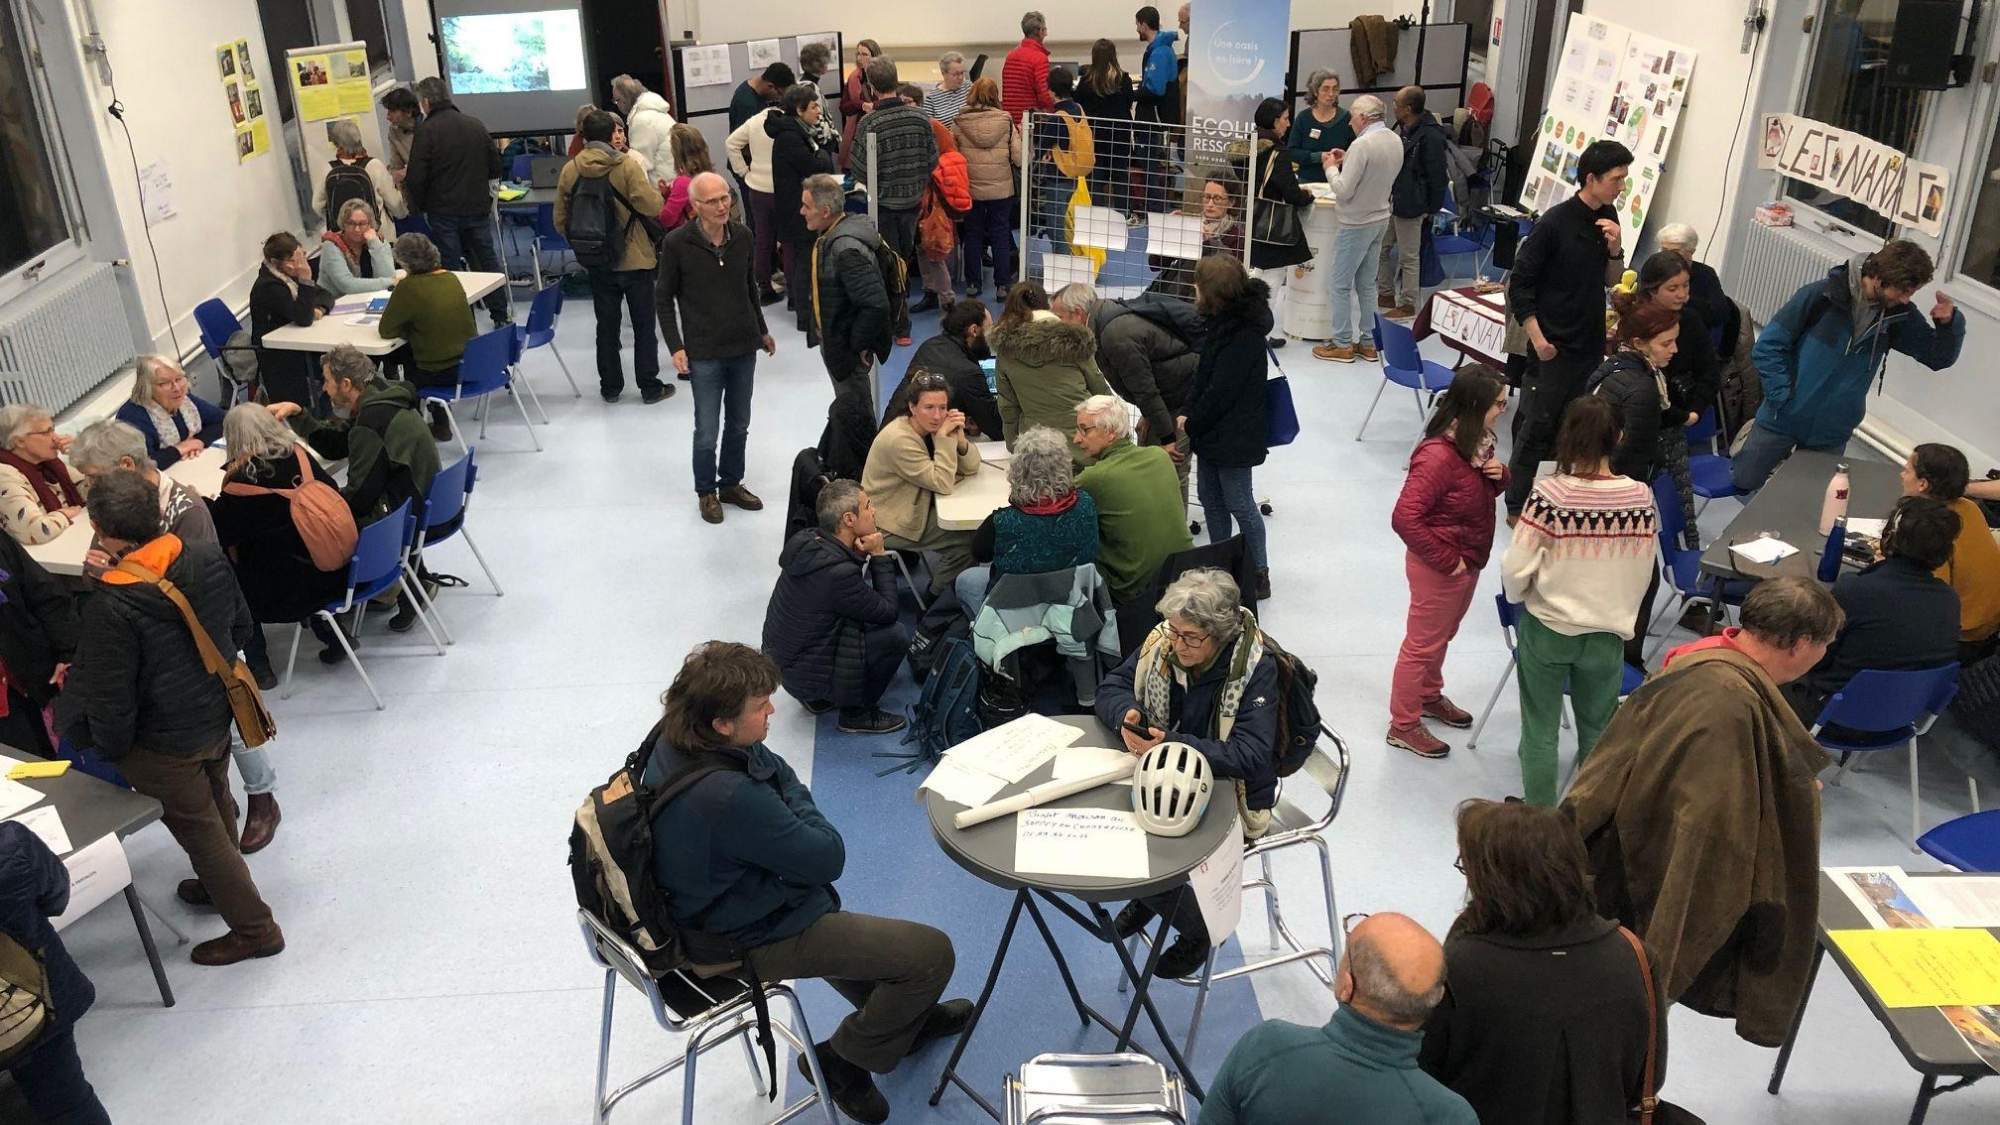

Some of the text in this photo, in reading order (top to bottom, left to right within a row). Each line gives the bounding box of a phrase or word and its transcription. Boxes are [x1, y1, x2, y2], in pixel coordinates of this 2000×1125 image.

[1235, 40, 1259, 51] oasis
[1192, 116, 1256, 140] ECOLI
[1778, 124, 1840, 181] LES
[1431, 300, 1470, 335] LES
